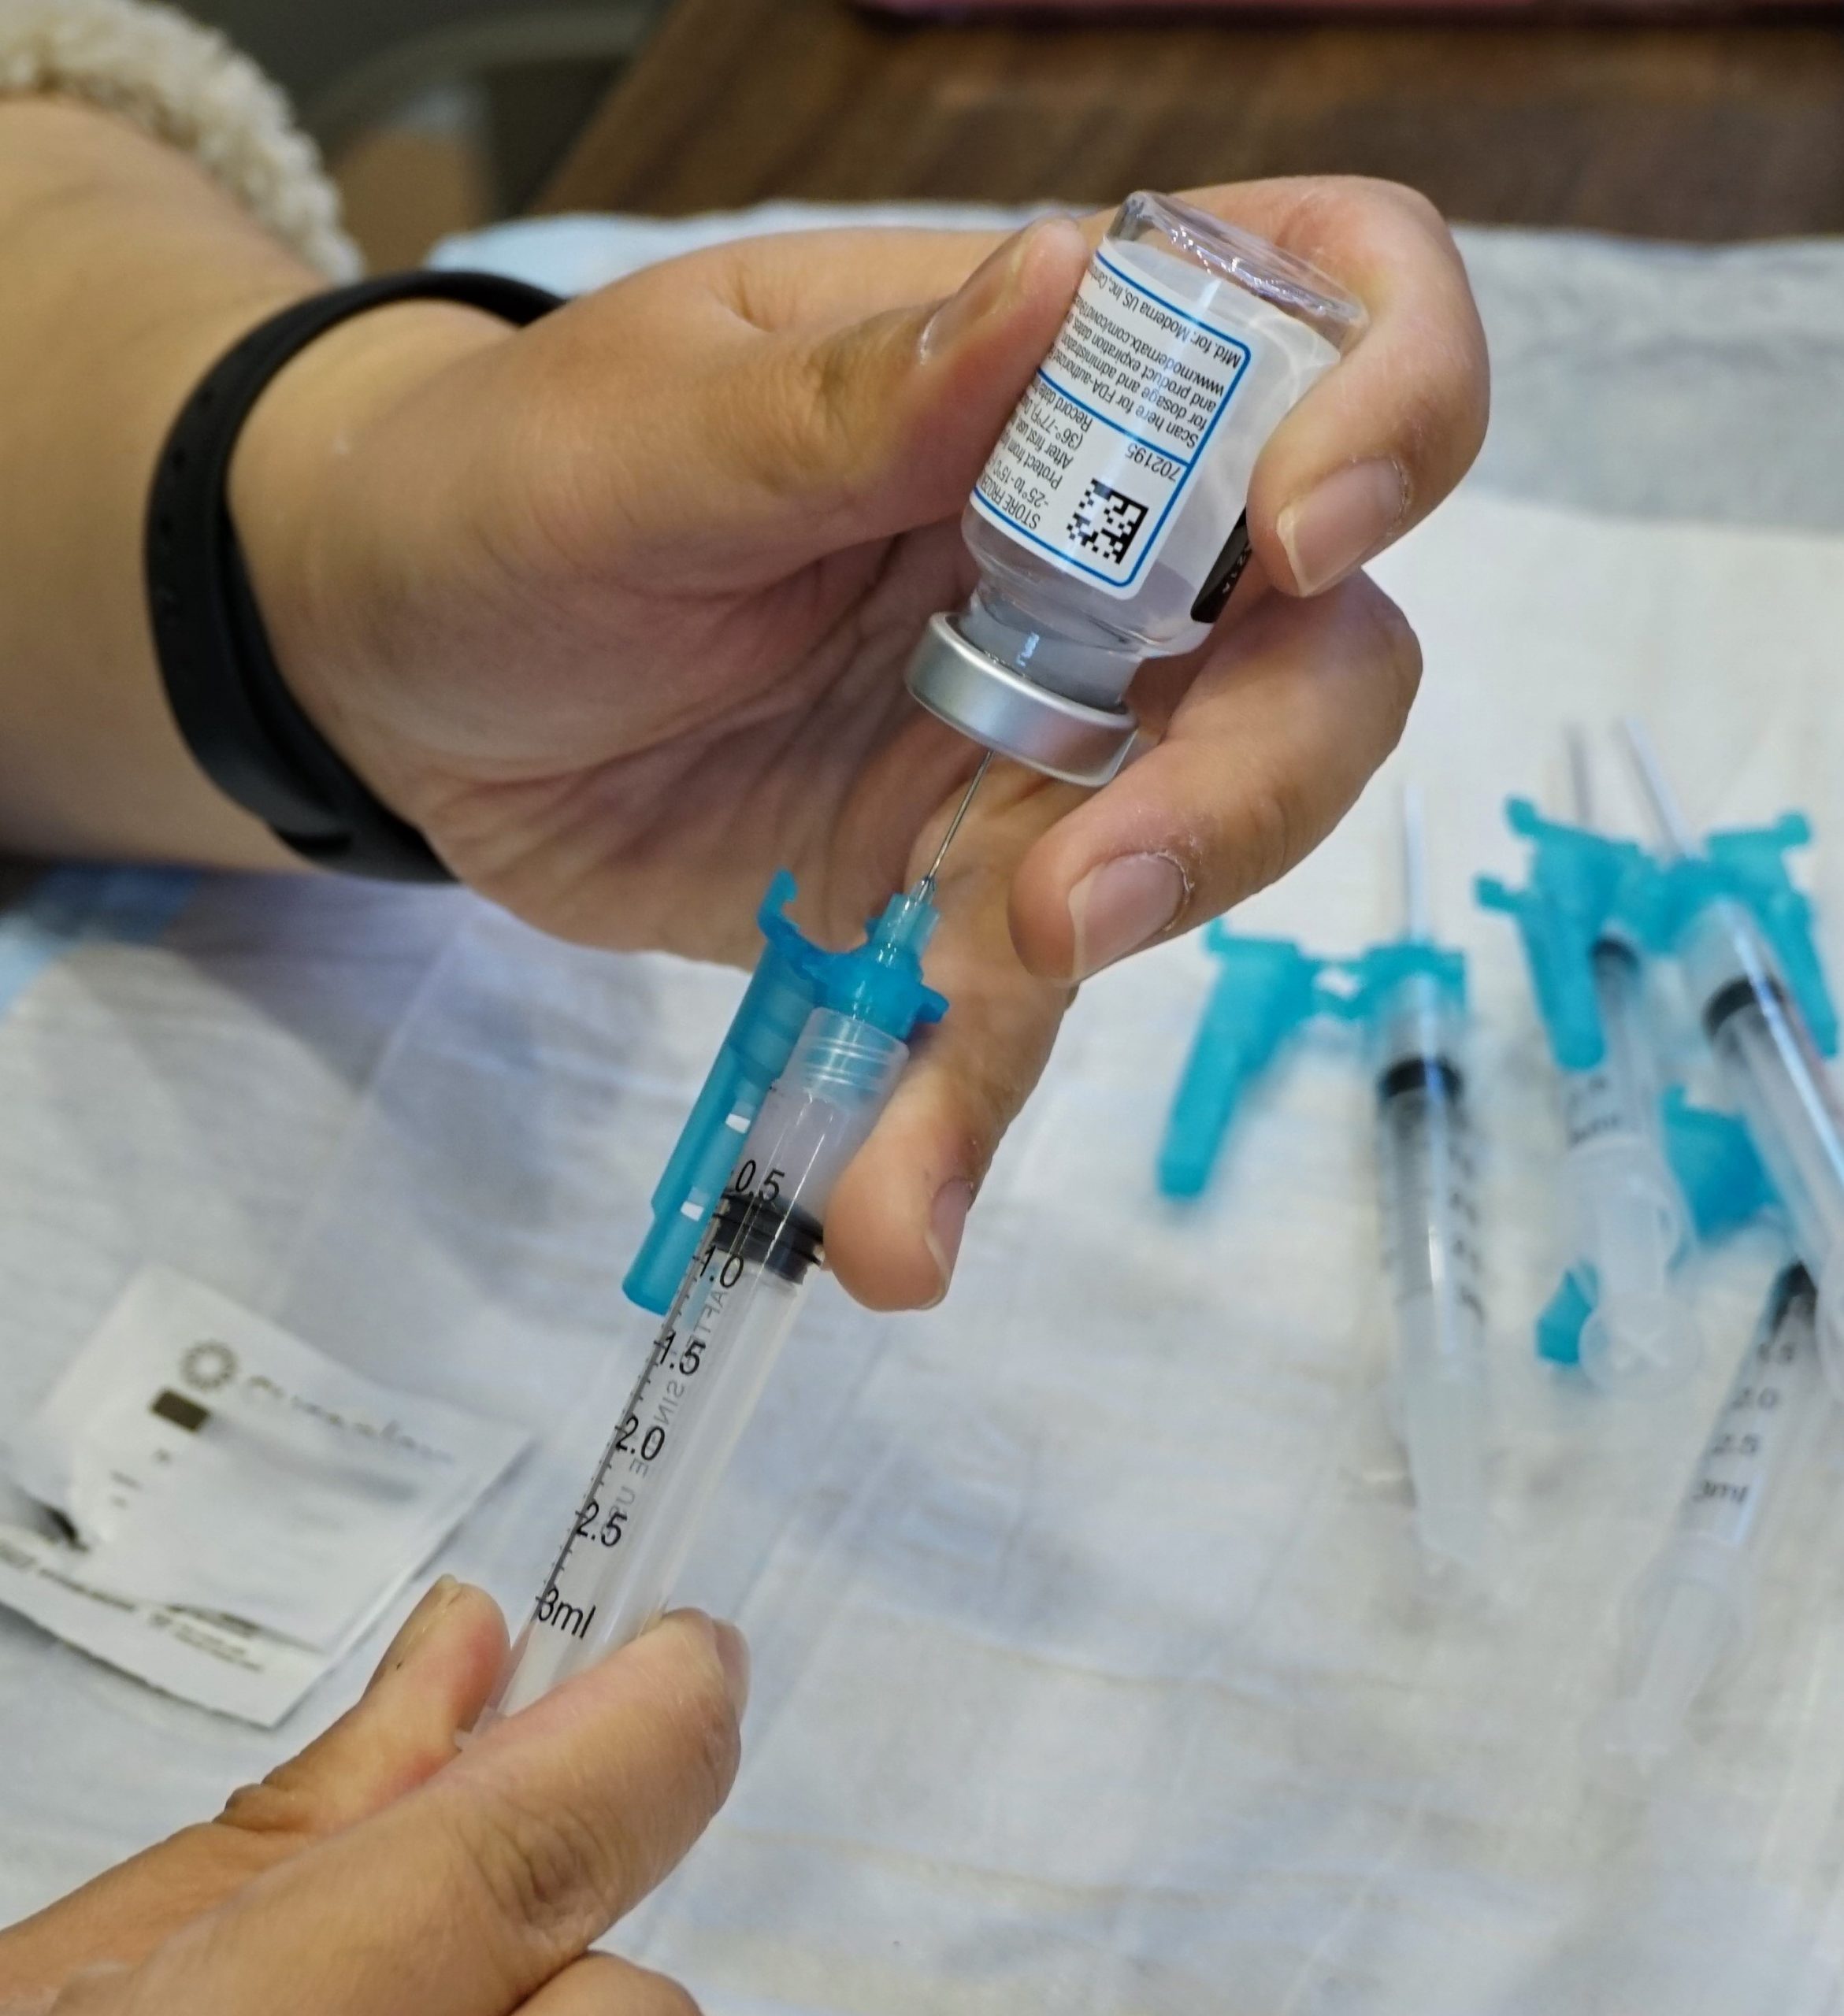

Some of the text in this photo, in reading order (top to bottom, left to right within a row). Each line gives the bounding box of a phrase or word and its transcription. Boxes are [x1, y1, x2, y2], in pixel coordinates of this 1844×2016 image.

[1118, 287, 1141, 312] US,
[1137, 301, 1191, 343] Moderna
[1089, 332, 1143, 373] expiration
[1188, 331, 1213, 354] for:
[1208, 343, 1242, 369] Mfd.
[1115, 371, 1141, 395] and
[1138, 364, 1192, 402] product
[1052, 396, 1093, 432] Record
[1113, 393, 1136, 414] for
[1132, 403, 1166, 432] here
[1139, 384, 1189, 421] dosage
[1188, 391, 1217, 416] and
[1025, 426, 1046, 452] first
[1163, 421, 1200, 450] Scan
[1185, 411, 1208, 432] for
[1005, 438, 1026, 463] from
[1043, 441, 1074, 471] After
[1122, 441, 1182, 482] 702195
[1011, 475, 1026, 494] to
[1021, 452, 1064, 490] Protect
[1000, 494, 1042, 530] STORE
[735, 1159, 785, 1202] 0.5
[699, 1244, 744, 1288] 1.0
[659, 1333, 706, 1377] 1.5
[614, 1416, 666, 1462] 2.0
[575, 1500, 628, 1547] 2.5
[538, 1588, 596, 1639] 3ml
